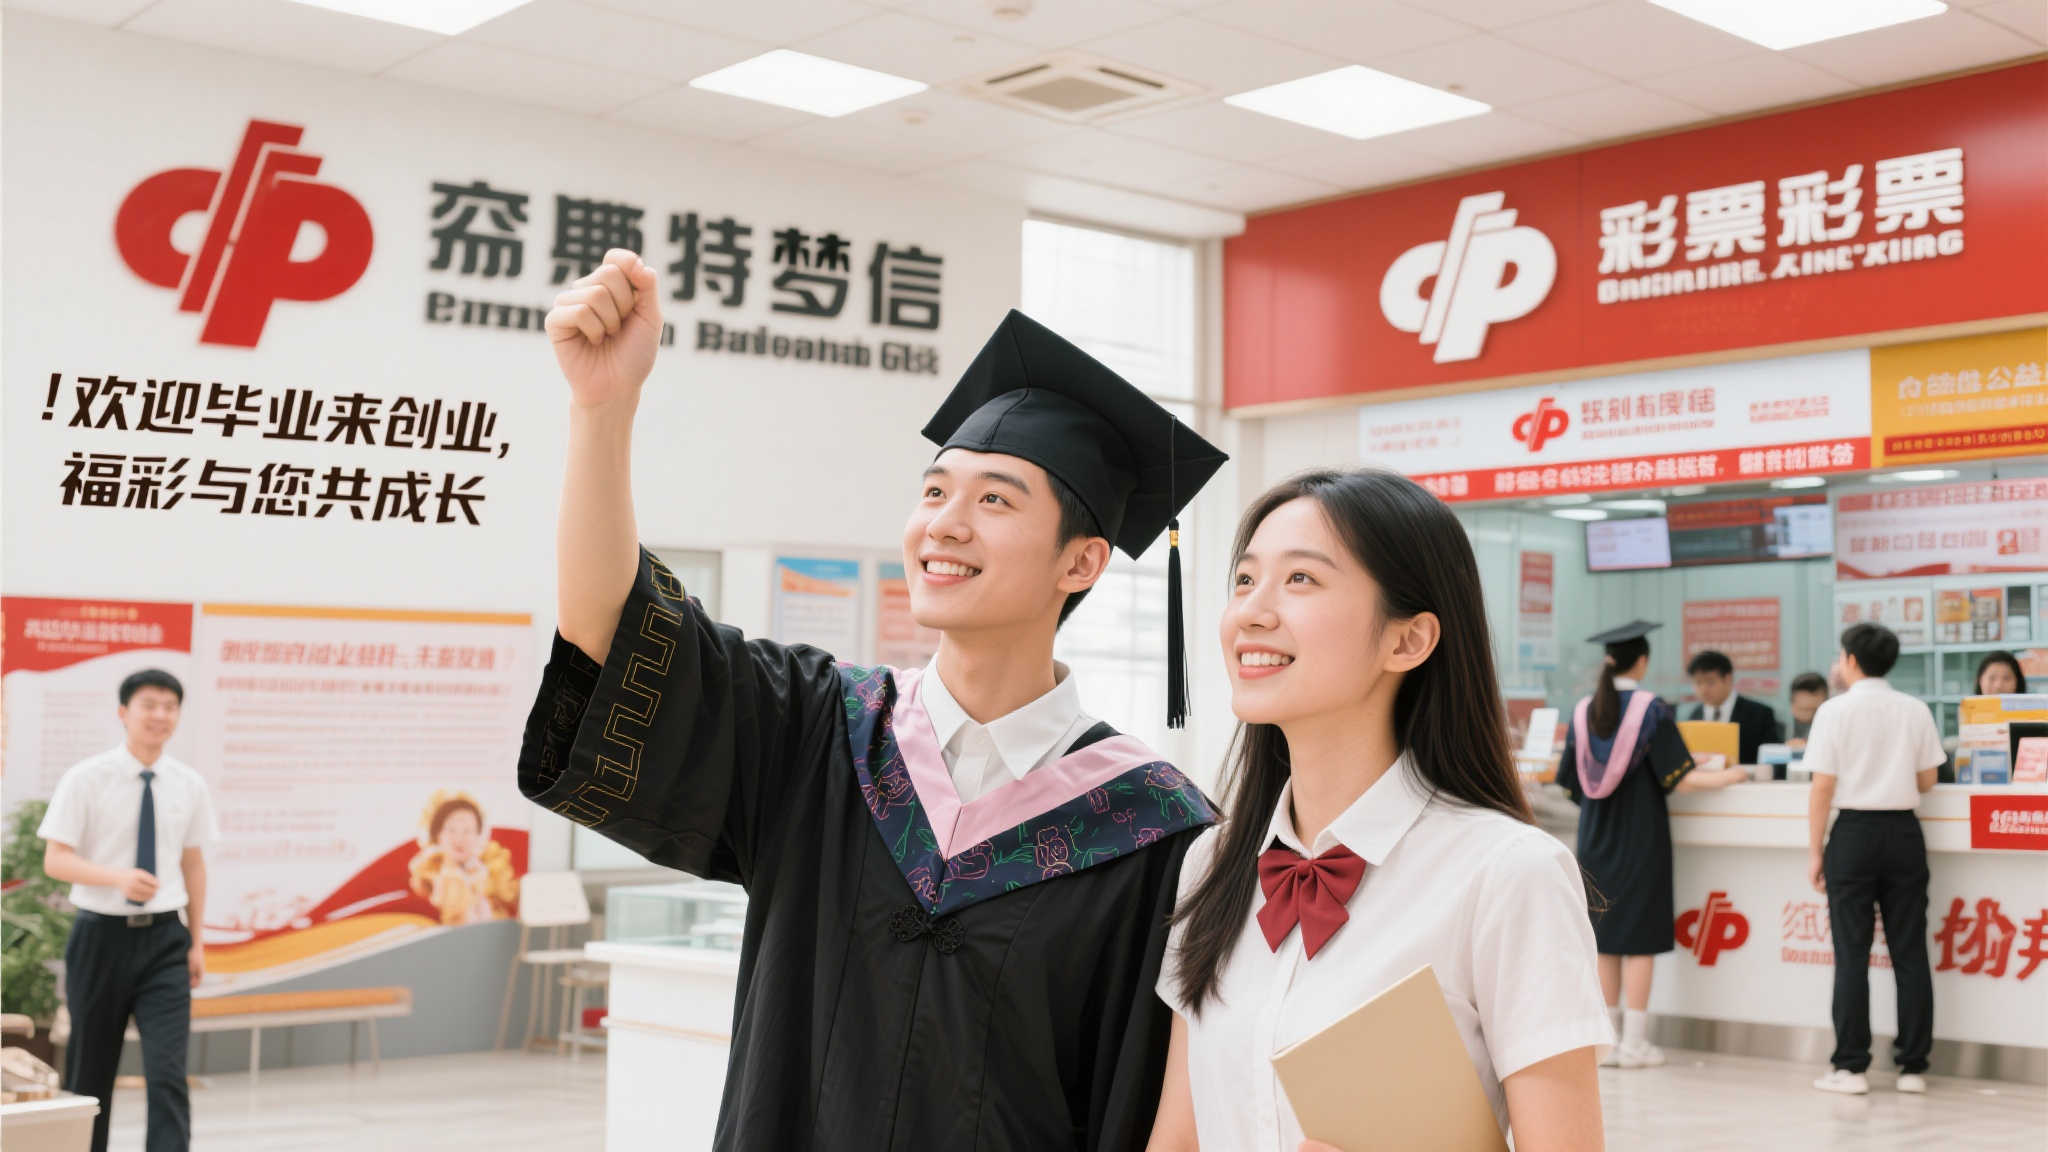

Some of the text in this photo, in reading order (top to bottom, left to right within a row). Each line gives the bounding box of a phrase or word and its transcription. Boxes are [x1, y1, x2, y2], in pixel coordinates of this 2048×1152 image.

[1598, 147, 1964, 274] 彩票彩票
[61, 452, 485, 525] 福彩与您共成长
